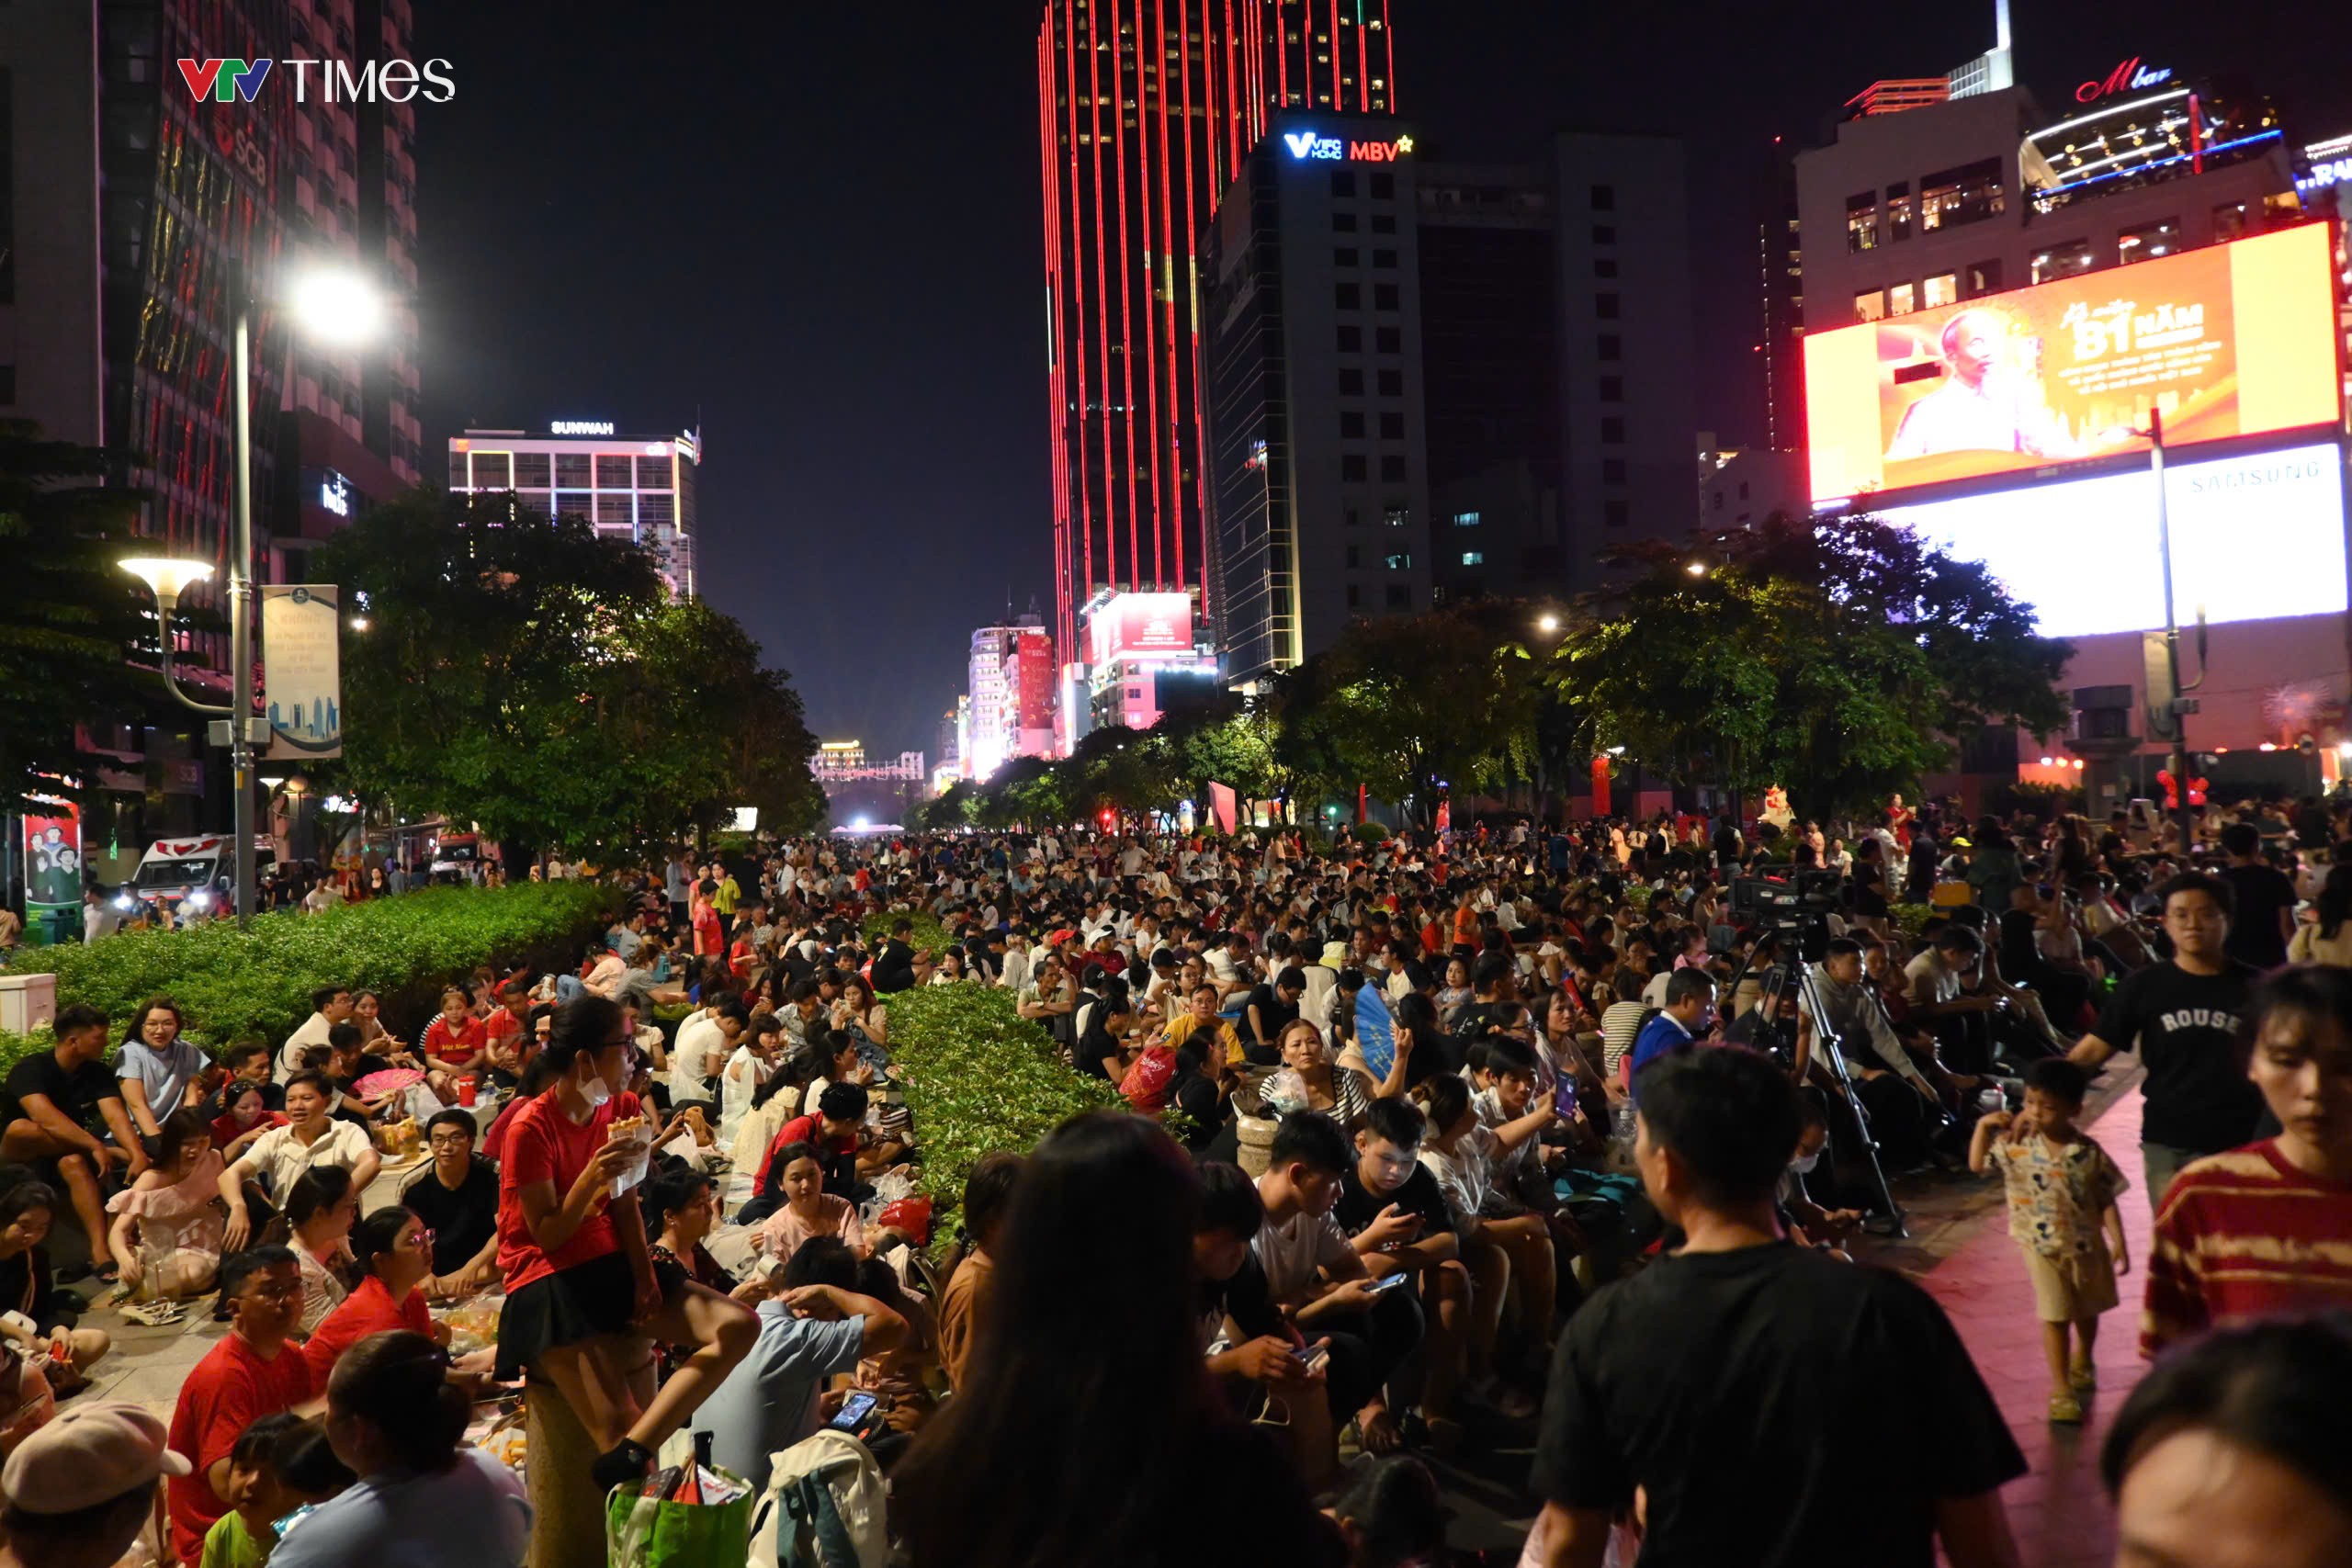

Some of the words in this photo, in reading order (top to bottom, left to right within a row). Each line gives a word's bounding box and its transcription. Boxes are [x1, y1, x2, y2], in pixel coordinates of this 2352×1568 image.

[236, 129, 266, 187] SCB
[1350, 141, 1398, 162] MBV
[551, 421, 615, 435] SUNWAH
[2191, 461, 2320, 493] SAMSUNG
[2160, 1009, 2242, 1034] ROUSE
